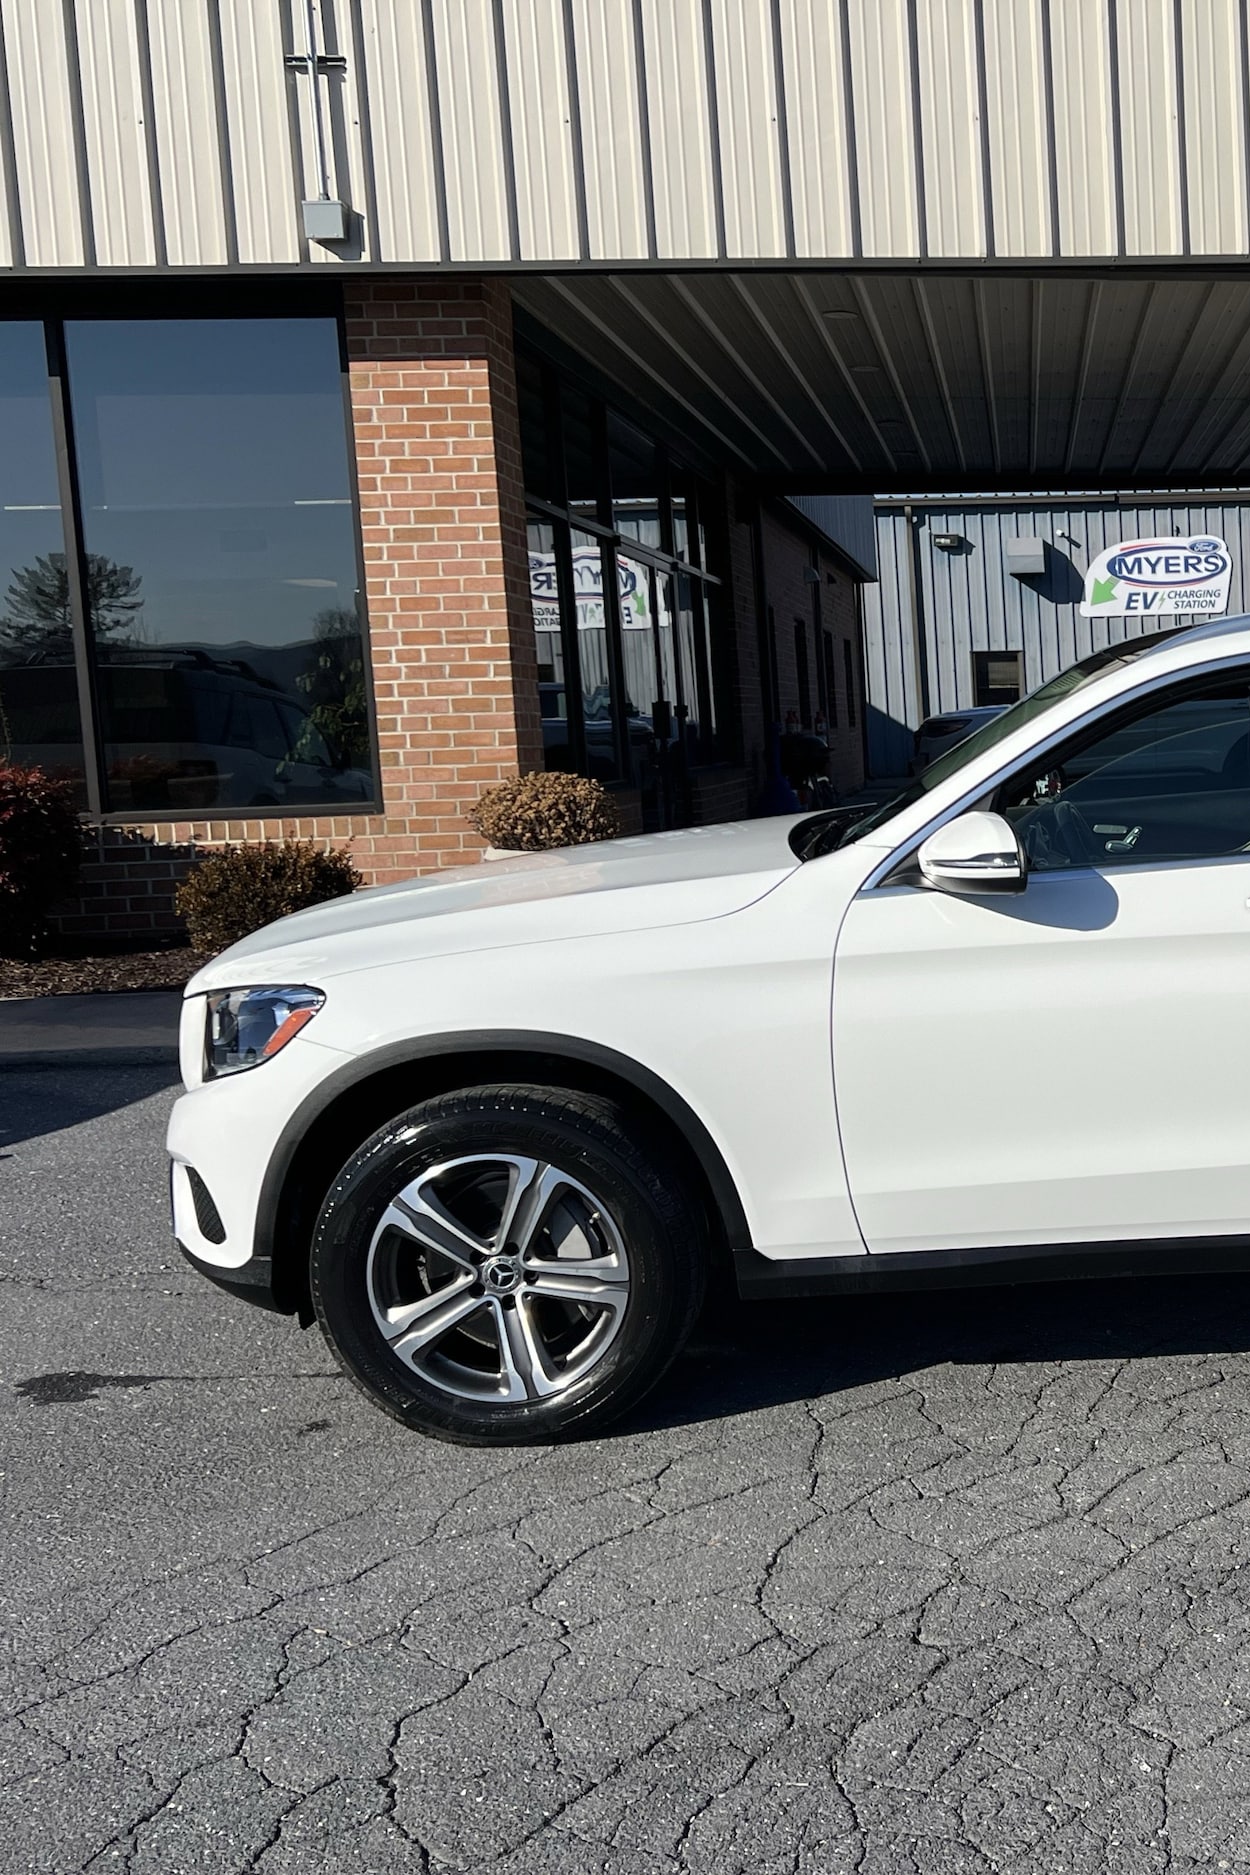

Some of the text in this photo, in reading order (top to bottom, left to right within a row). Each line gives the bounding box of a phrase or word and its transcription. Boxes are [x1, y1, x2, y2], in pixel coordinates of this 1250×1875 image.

[1194, 542, 1213, 552] Ford
[1117, 556, 1220, 575] MYERS
[1125, 589, 1221, 611] EV CHARGING
[1174, 600, 1216, 609] STATION
